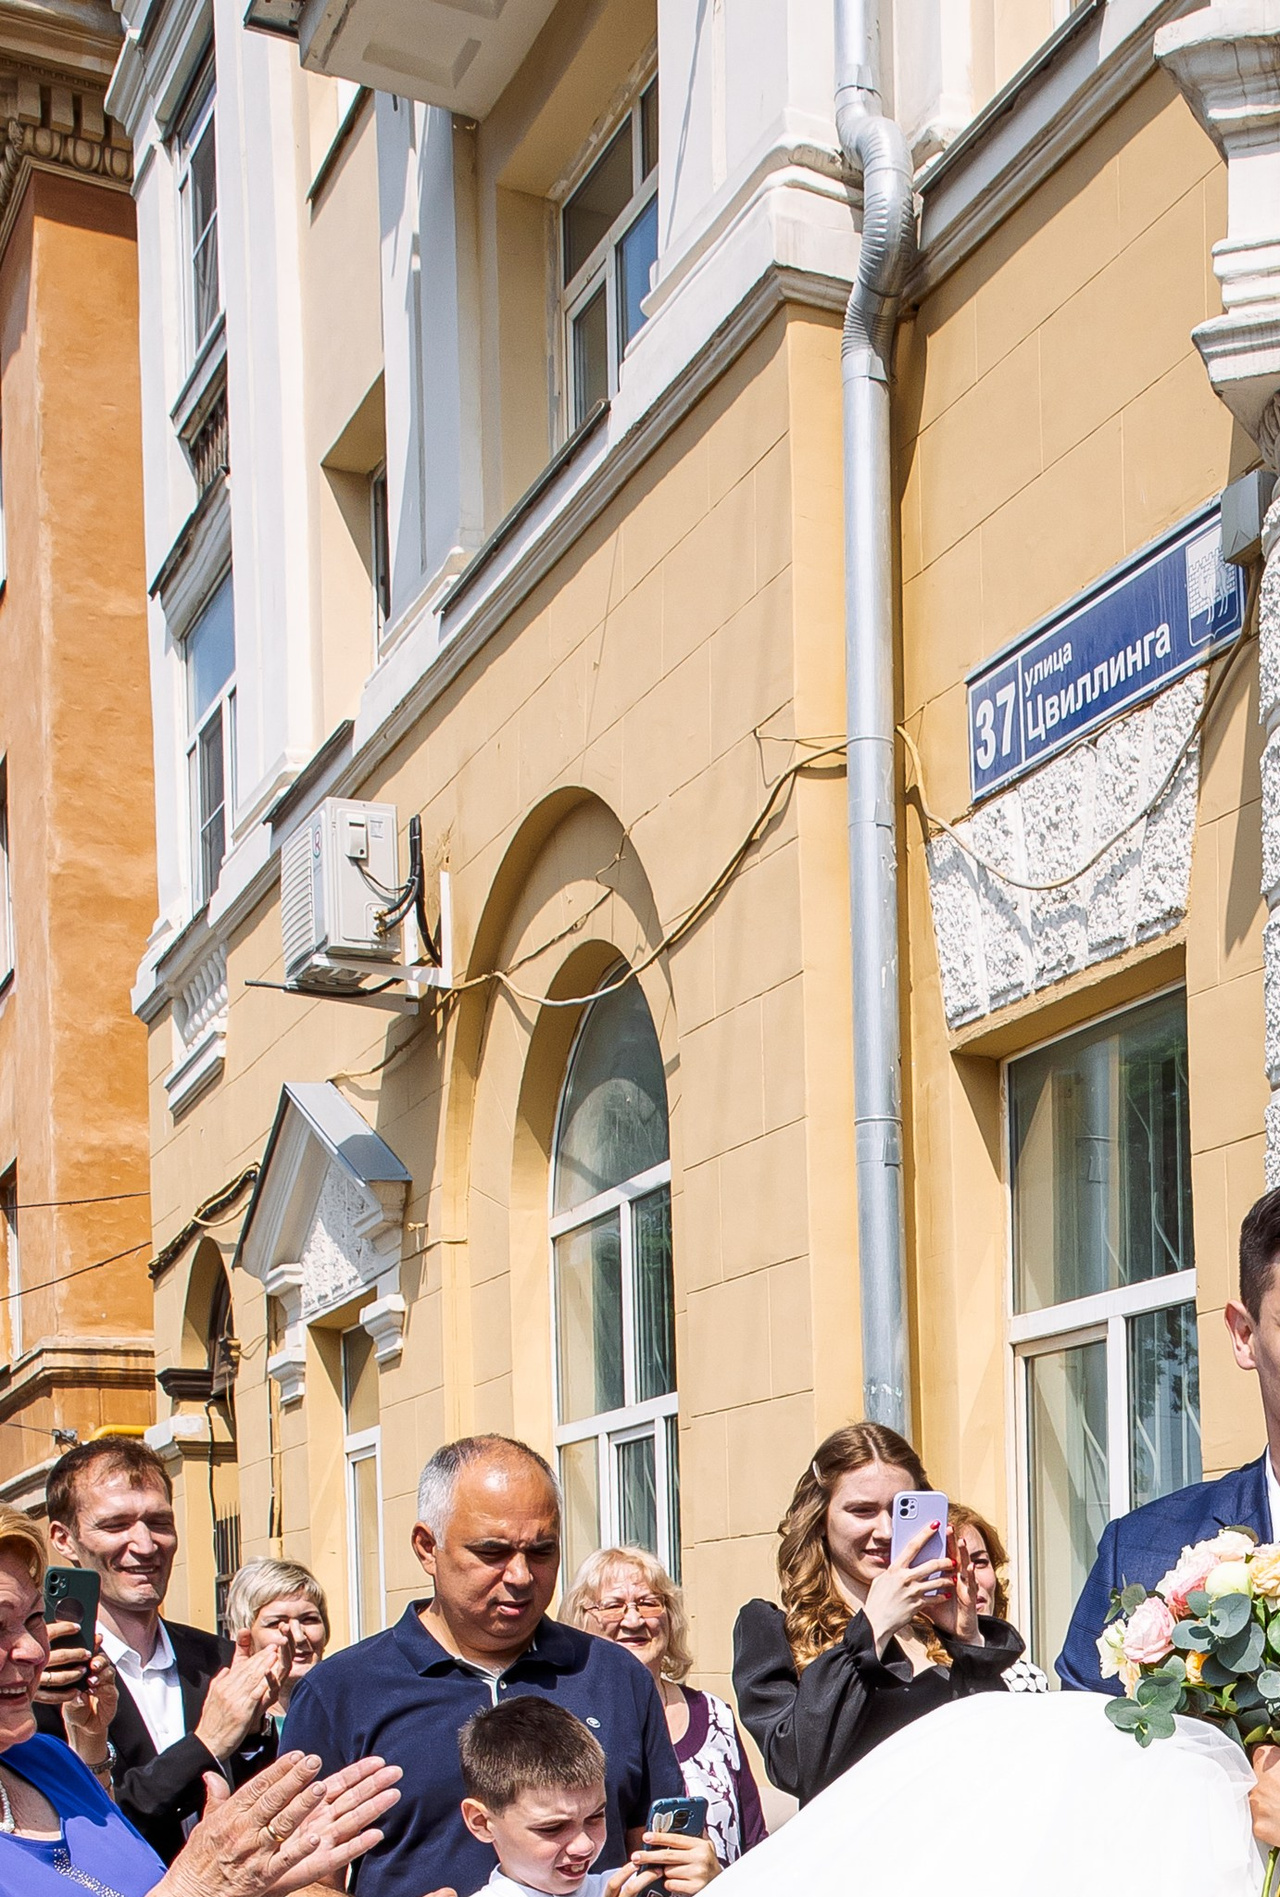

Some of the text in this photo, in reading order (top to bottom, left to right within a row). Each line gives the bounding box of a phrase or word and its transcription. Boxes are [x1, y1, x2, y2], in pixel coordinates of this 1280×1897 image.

[1024, 641, 1073, 698] улица
[1026, 622, 1172, 742] Цвиллинга
[975, 681, 1016, 771] 37
